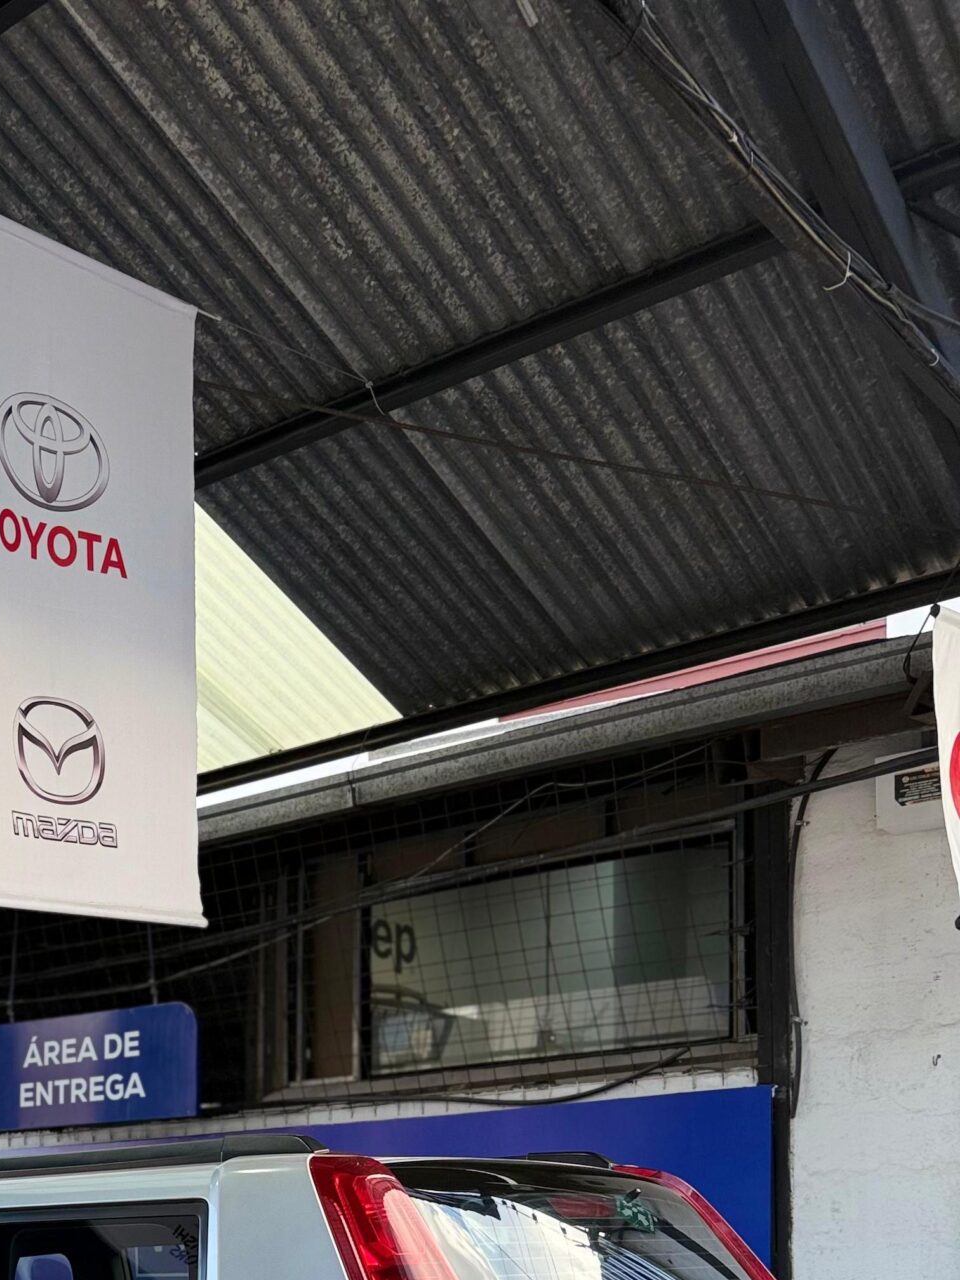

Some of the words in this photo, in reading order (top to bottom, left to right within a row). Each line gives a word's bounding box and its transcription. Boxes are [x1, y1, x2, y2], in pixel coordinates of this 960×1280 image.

[23, 1035, 97, 1068] ÁREA
[104, 1030, 140, 1060] DE
[19, 1072, 146, 1108] ENTREGA
